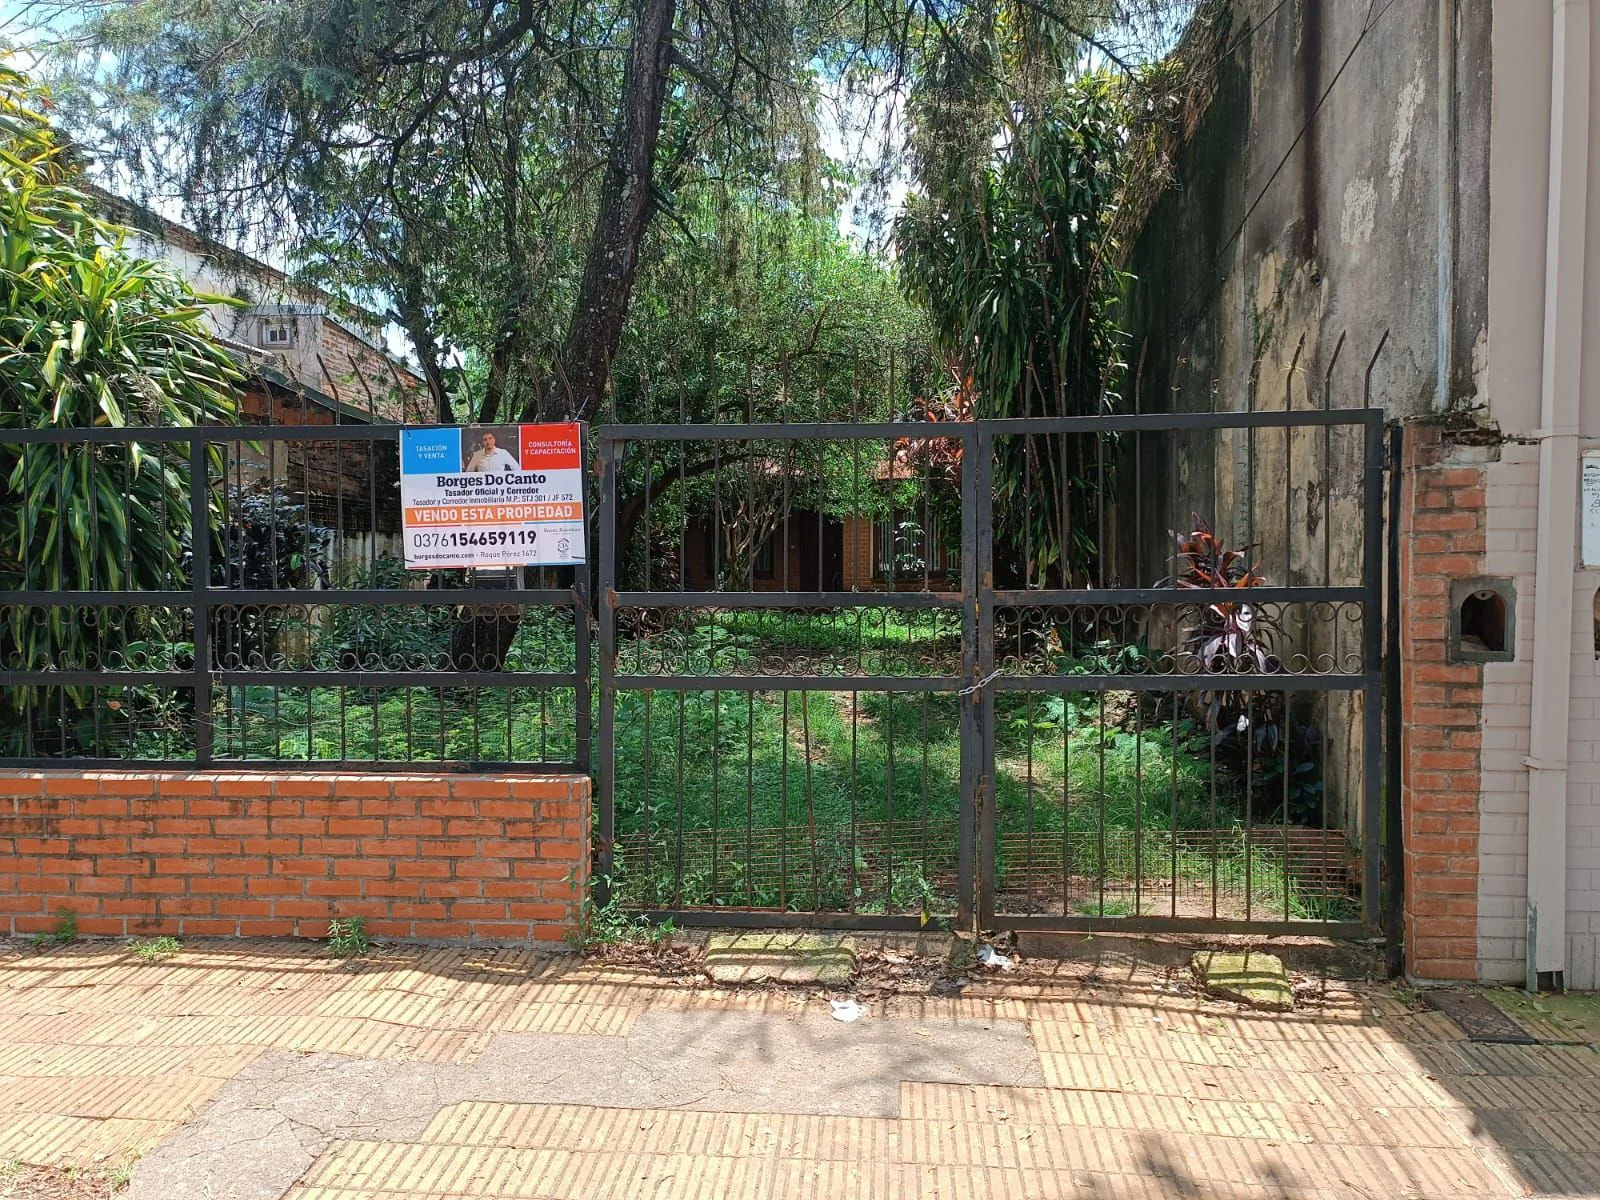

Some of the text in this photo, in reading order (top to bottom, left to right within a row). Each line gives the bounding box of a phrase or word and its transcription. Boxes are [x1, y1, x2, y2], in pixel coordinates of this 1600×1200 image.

[415, 443, 447, 452] TASACIÓN
[528, 439, 572, 448] CONSULTORÍA
[530, 447, 576, 455] CAPACITACIÓN
[437, 473, 546, 488] Borges Do Canto
[444, 489, 474, 497] Tasador
[475, 487, 498, 496] Oficial
[506, 487, 539, 495] Corredor
[534, 494, 546, 502] 301
[414, 505, 573, 522] VENDO ESTA PROPIEDAD
[414, 552, 475, 560] borgesdocanto.com
